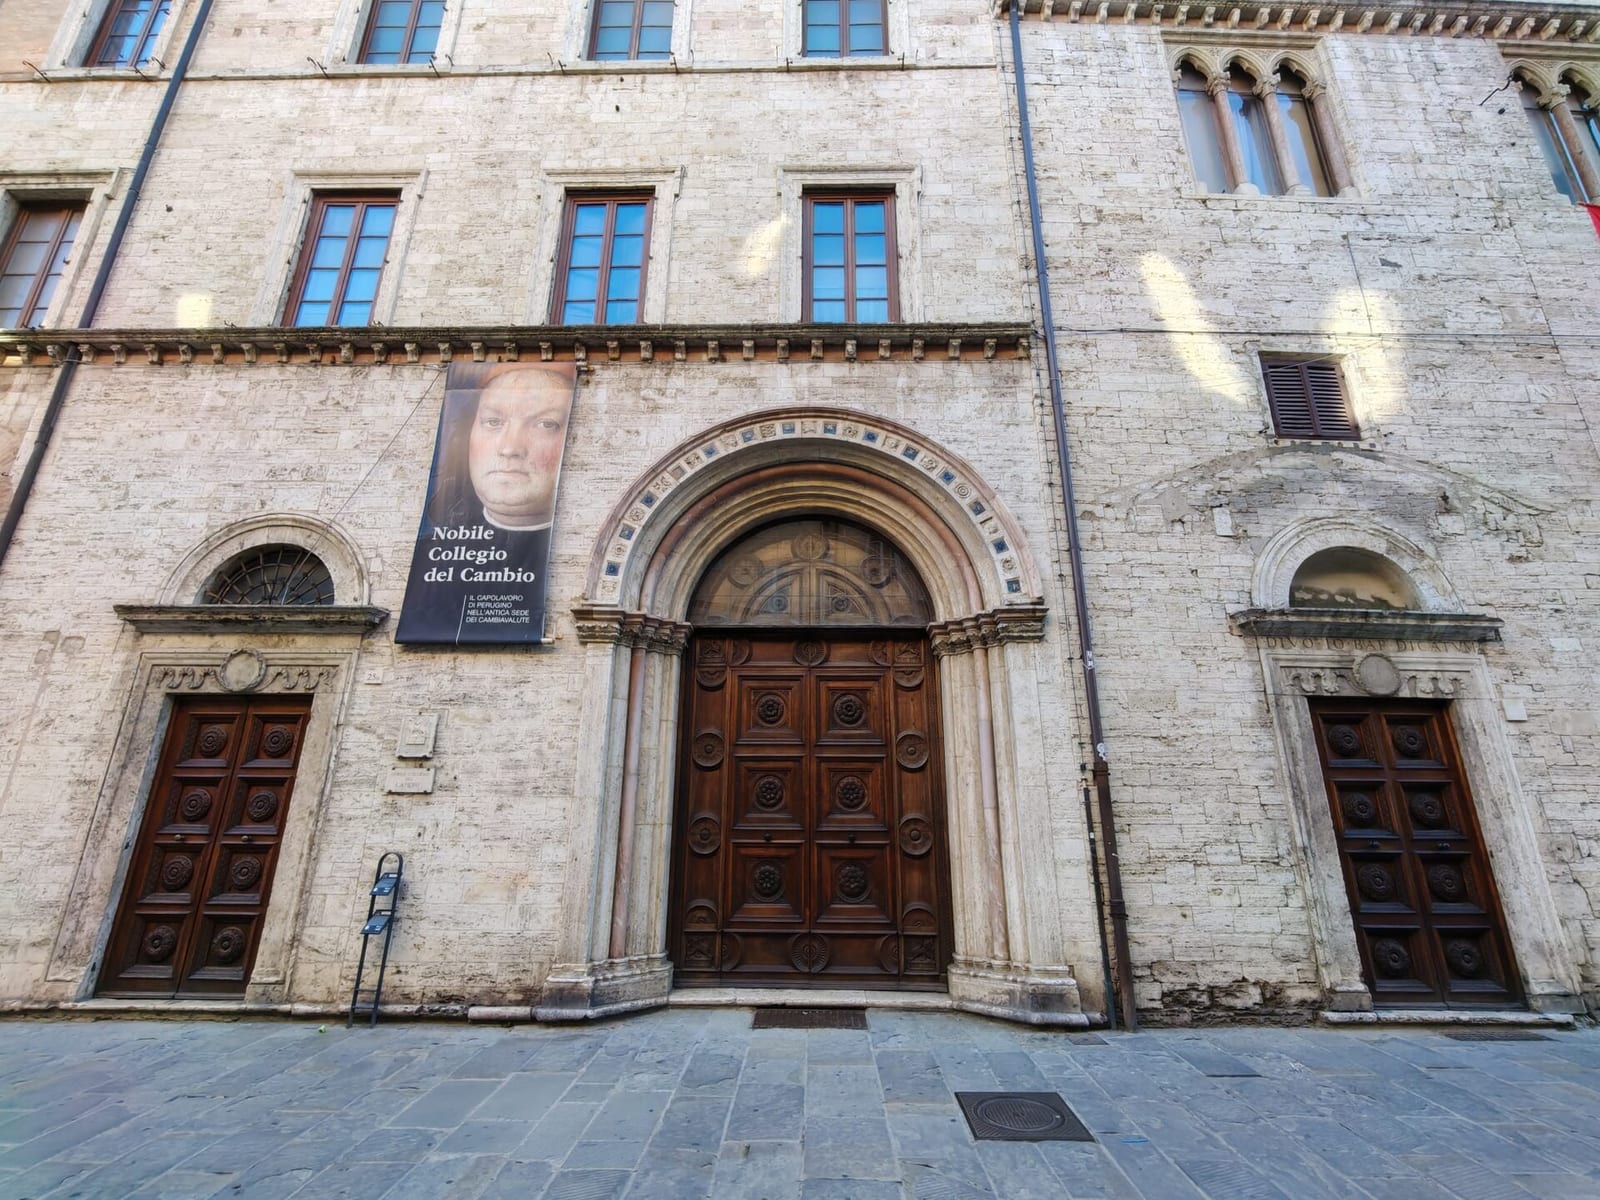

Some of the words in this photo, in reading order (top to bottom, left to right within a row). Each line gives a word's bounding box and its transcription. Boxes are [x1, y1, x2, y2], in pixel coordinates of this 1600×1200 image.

[431, 525, 495, 540] Nobile
[428, 546, 508, 565] Collegio
[423, 567, 454, 582] del
[460, 567, 536, 583] Cambio
[476, 594, 524, 602] CAPOLAVORO
[468, 601, 476, 609] DI
[476, 601, 513, 609] PERUGINO
[465, 616, 477, 624] DEI
[478, 616, 530, 624] CAMBIAVALUTE
